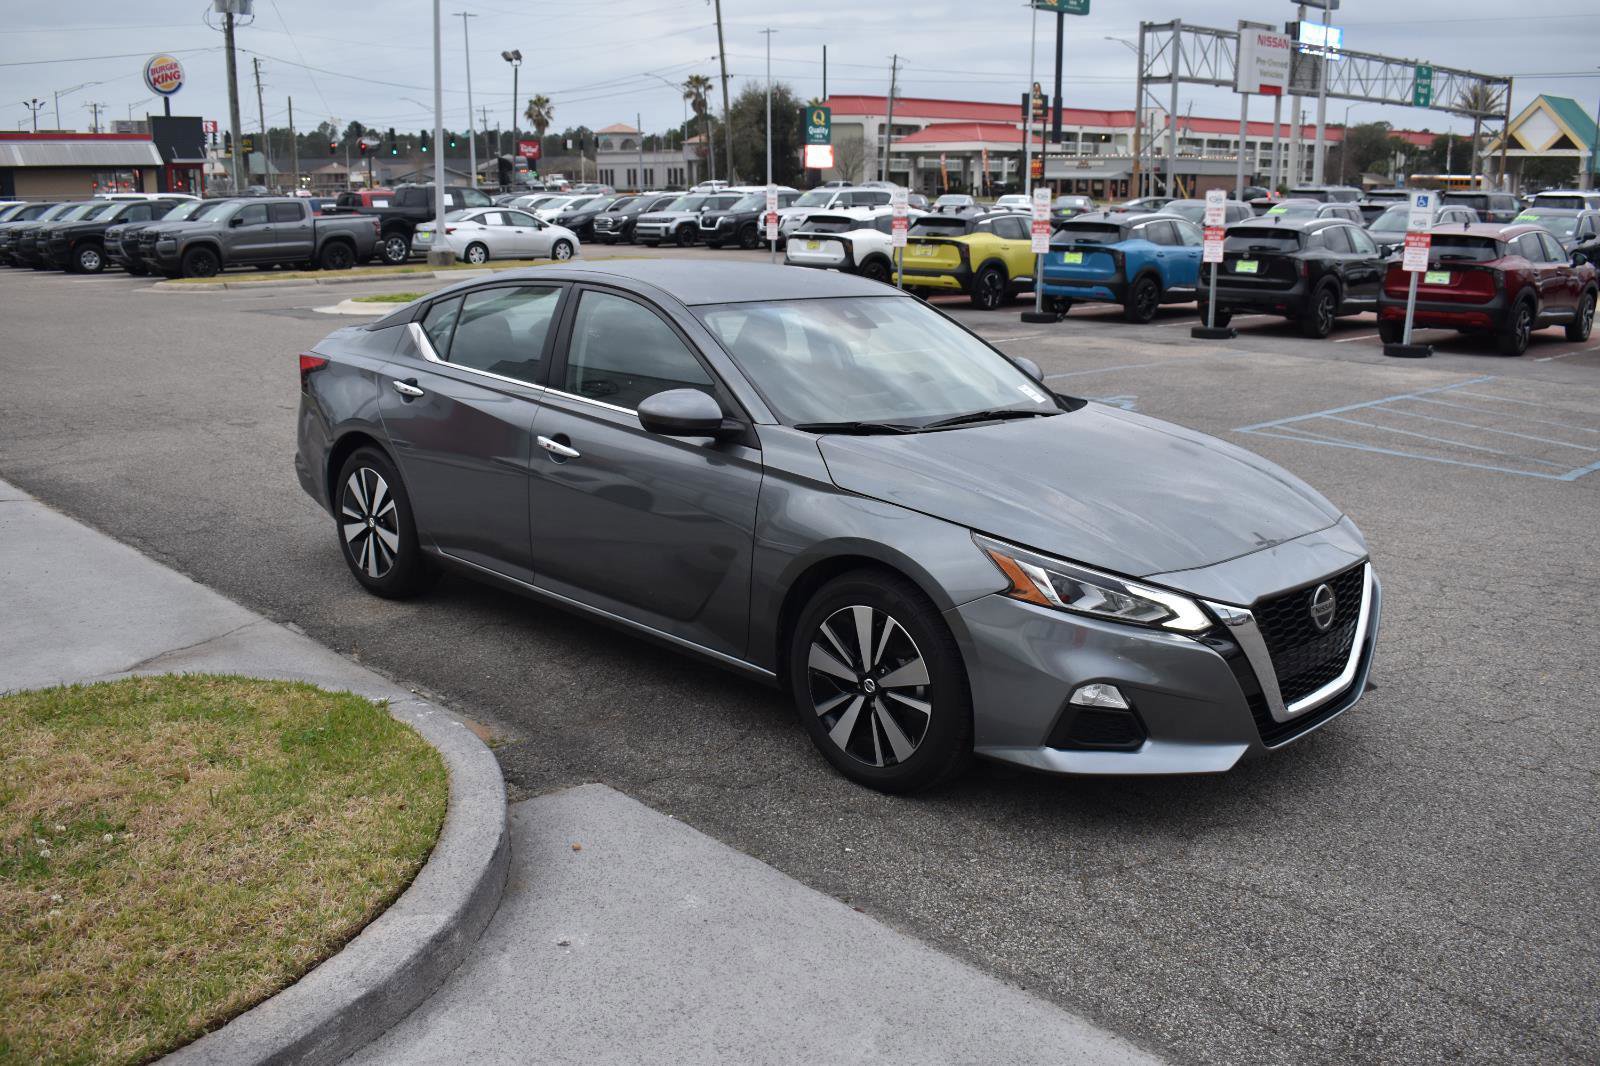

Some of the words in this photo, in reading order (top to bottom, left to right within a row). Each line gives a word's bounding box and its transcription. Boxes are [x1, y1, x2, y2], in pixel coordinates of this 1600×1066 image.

[1257, 34, 1289, 49] NISSAN
[150, 62, 179, 76] BURGER
[153, 70, 181, 86] KING
[808, 126, 829, 136] Quality
